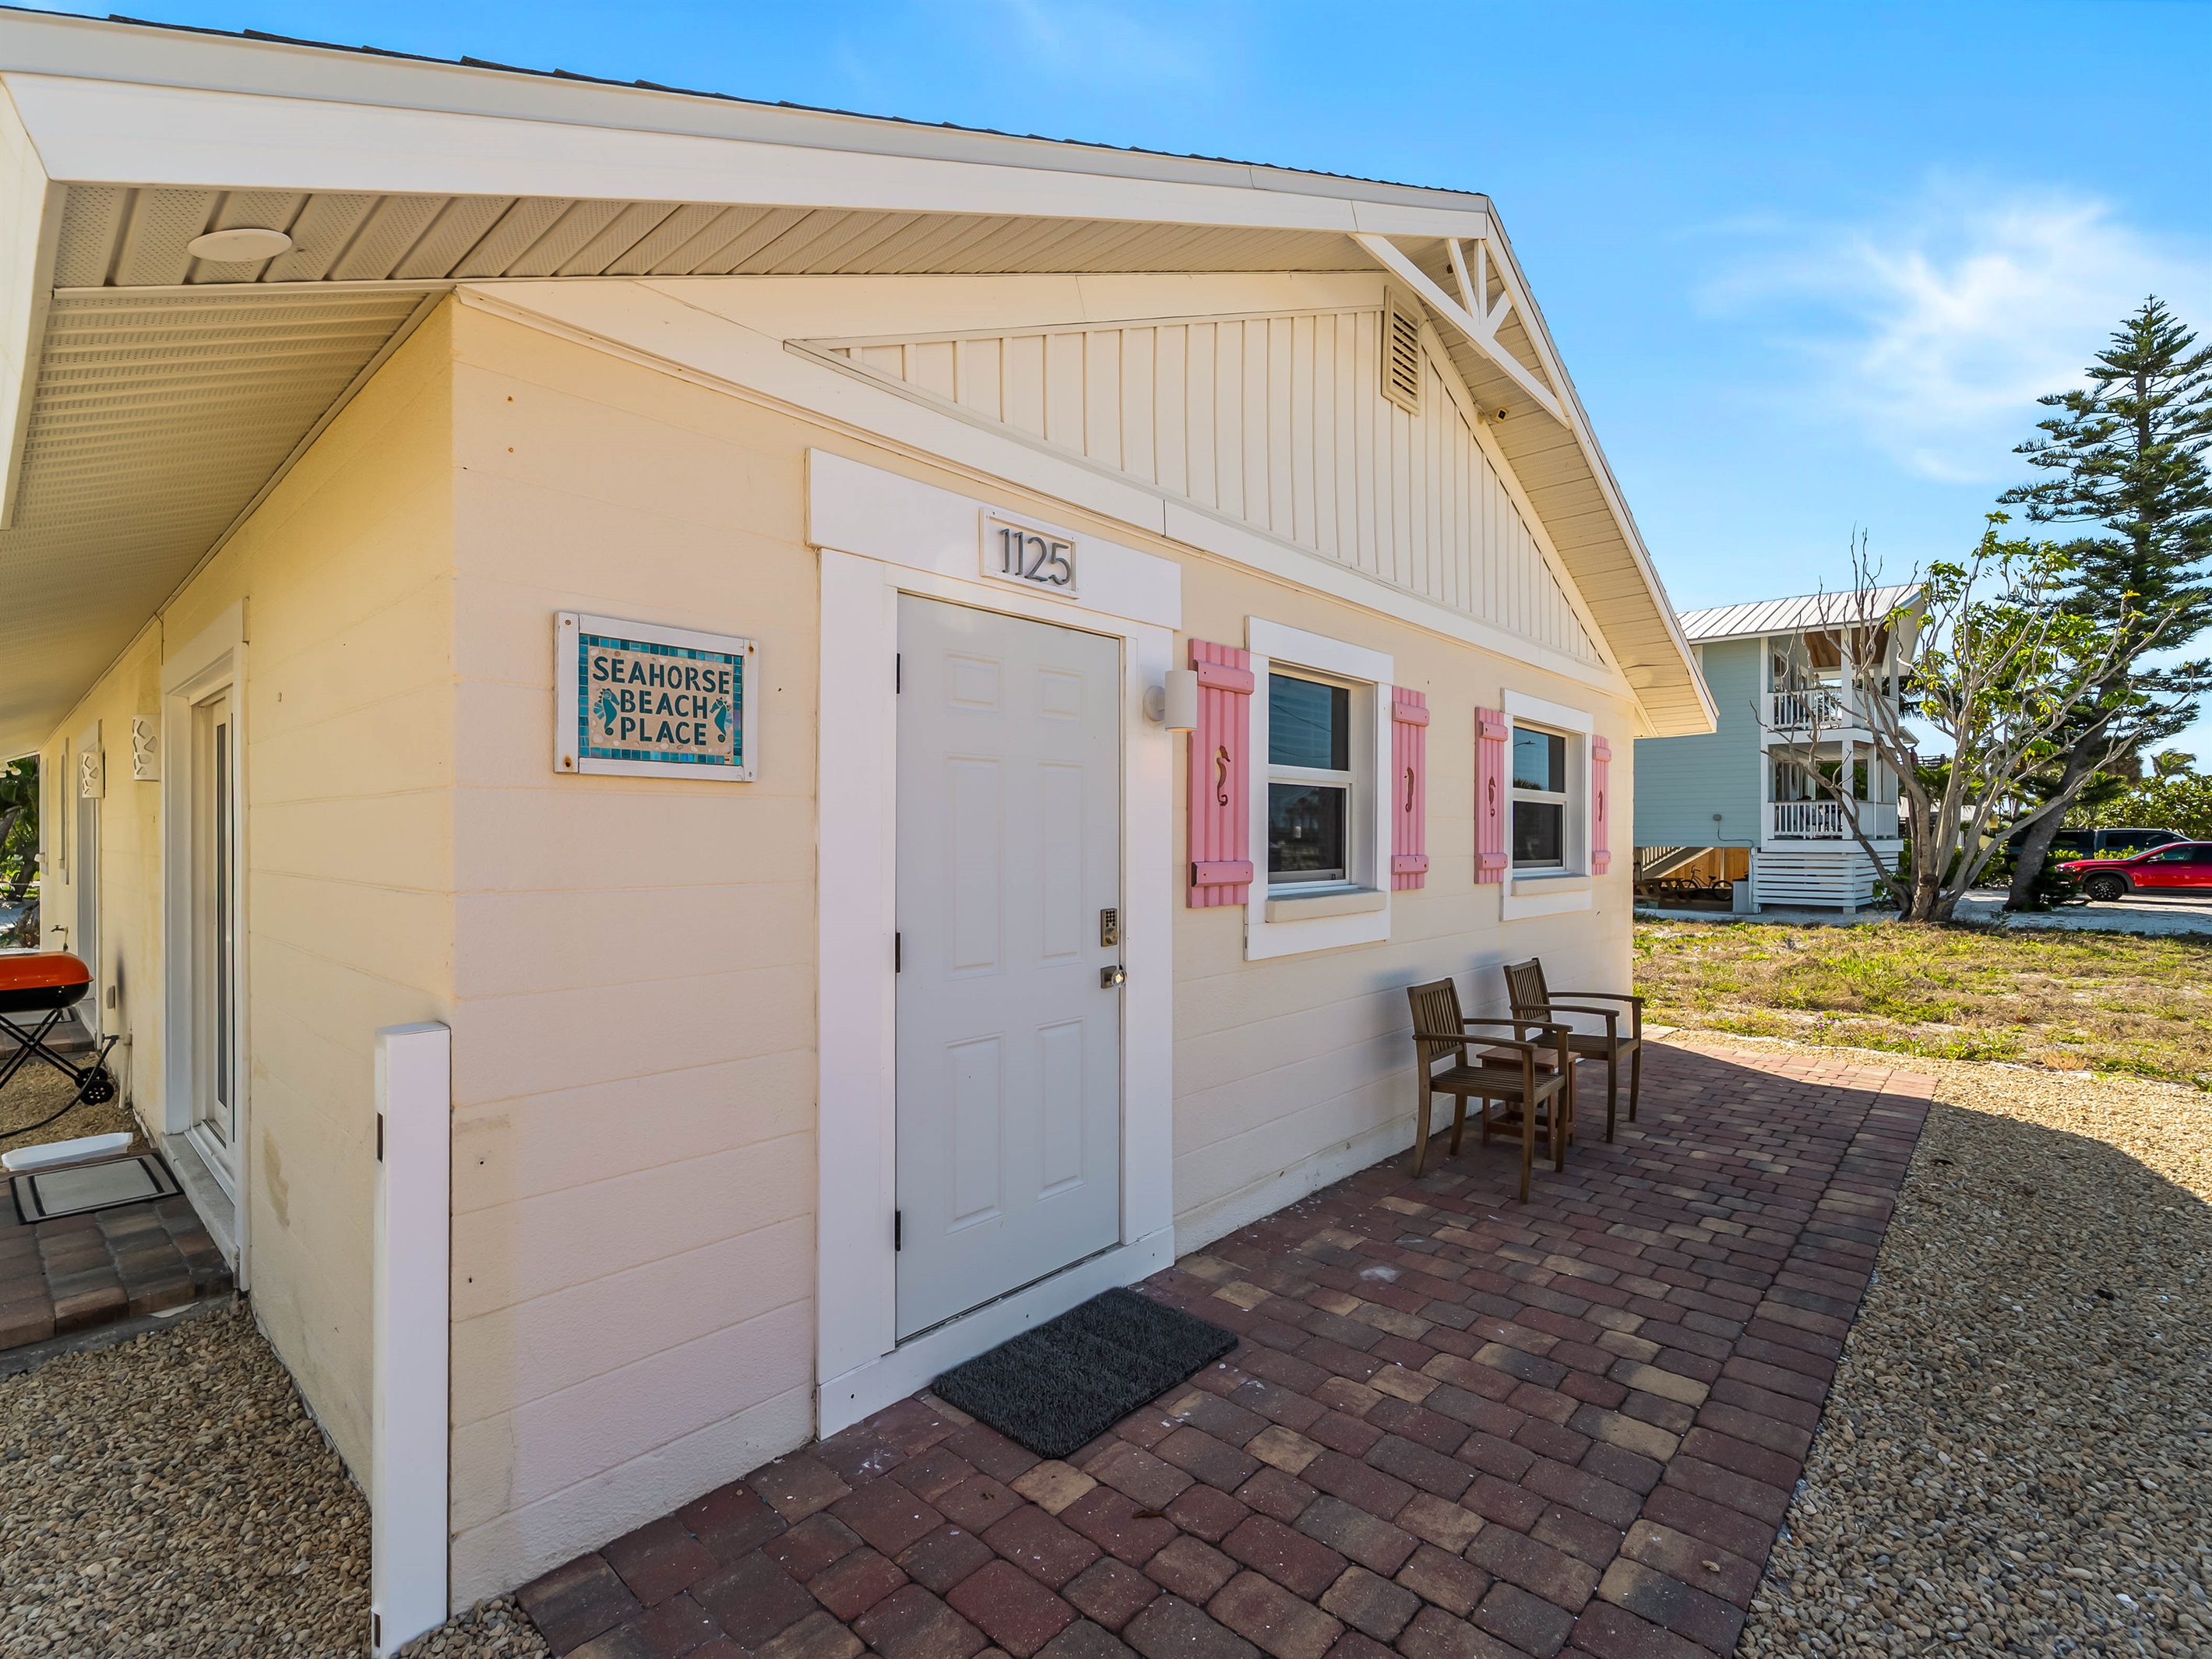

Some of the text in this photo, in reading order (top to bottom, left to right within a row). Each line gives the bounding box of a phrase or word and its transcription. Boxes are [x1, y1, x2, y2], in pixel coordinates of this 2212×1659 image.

[999, 528, 1071, 585] 1125
[592, 656, 730, 694] SEAHORSE
[620, 689, 707, 719] BEACH
[620, 717, 707, 745] PLACE
